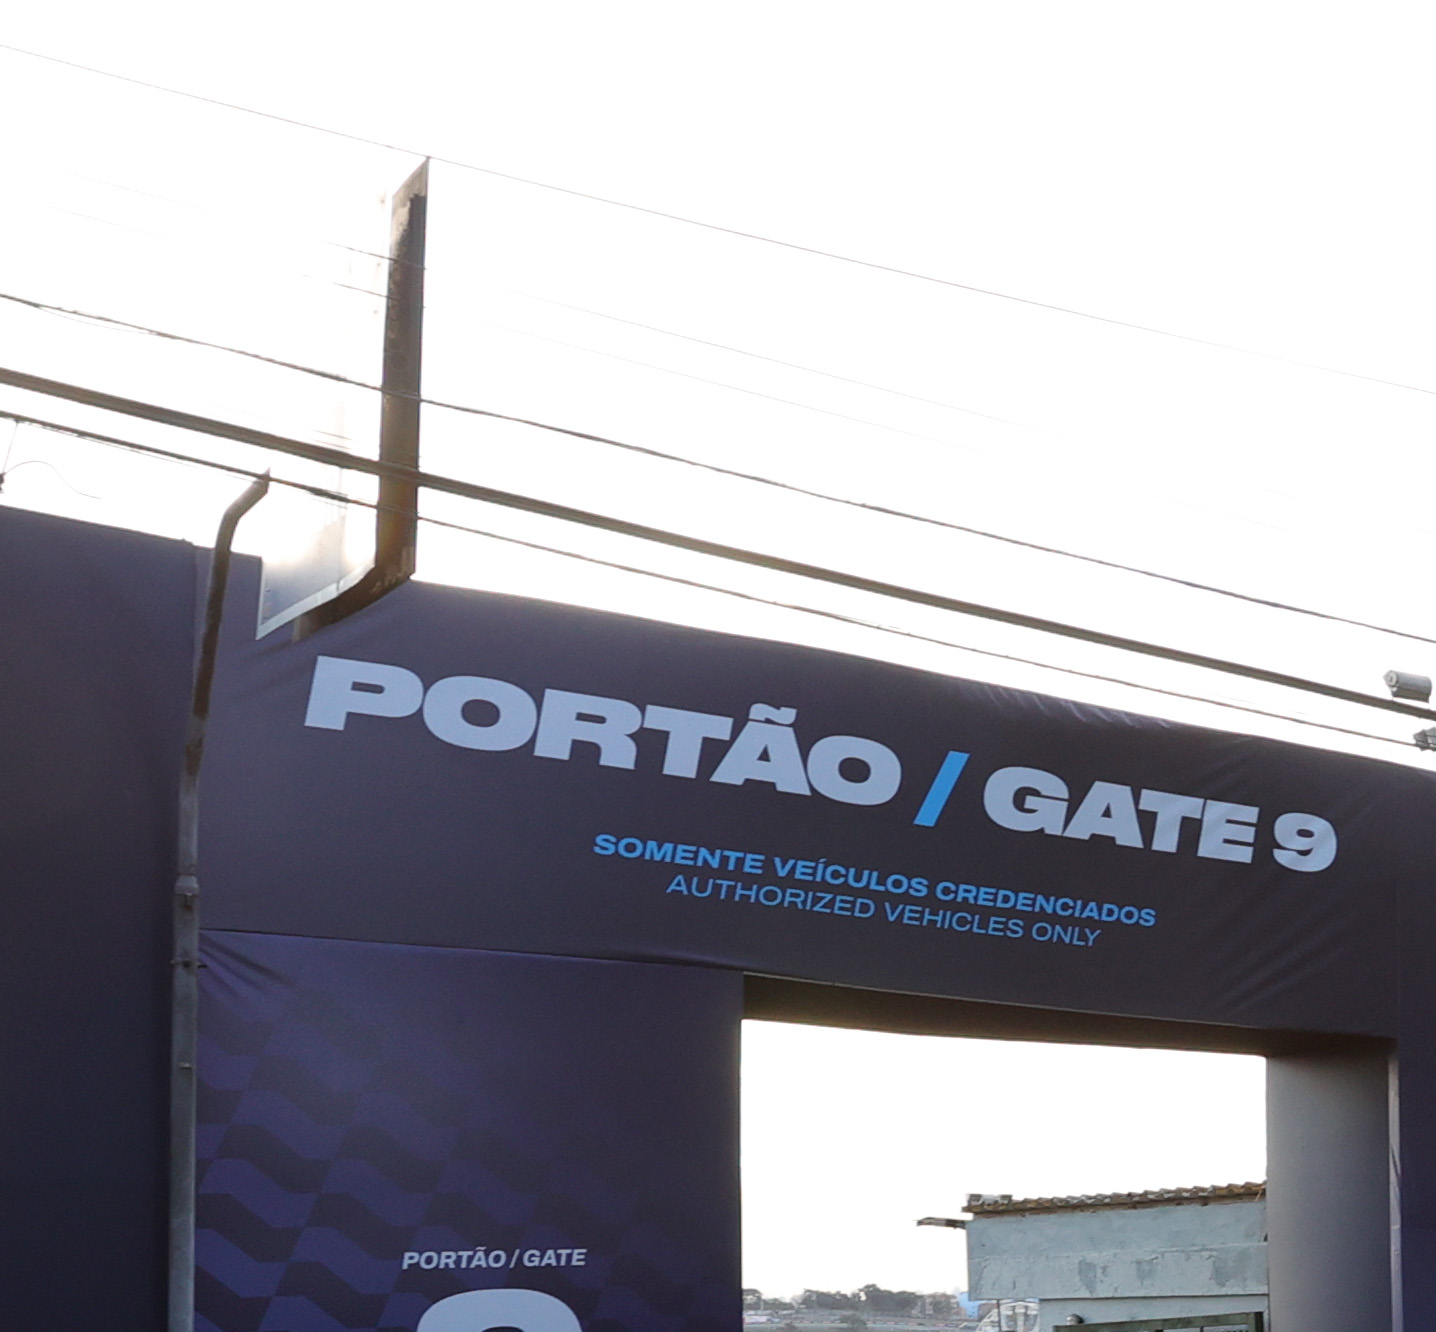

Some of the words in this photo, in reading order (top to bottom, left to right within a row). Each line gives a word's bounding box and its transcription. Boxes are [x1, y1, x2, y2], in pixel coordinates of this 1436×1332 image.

[304, 654, 902, 806] PORTÃO
[912, 751, 971, 827] /
[983, 767, 1260, 863] GATE
[1271, 811, 1338, 873] 9
[593, 834, 765, 874] SOMENTE
[773, 858, 929, 897] VEÍCULOS
[935, 881, 1157, 927] CREDENCIADOS
[666, 874, 876, 919] AUTHORIZED
[884, 902, 1024, 939] VEHICLES
[1031, 922, 1102, 948] ONLY
[402, 1246, 507, 1270] PORTÃO
[509, 1249, 520, 1268] /
[522, 1249, 587, 1267] GATE
